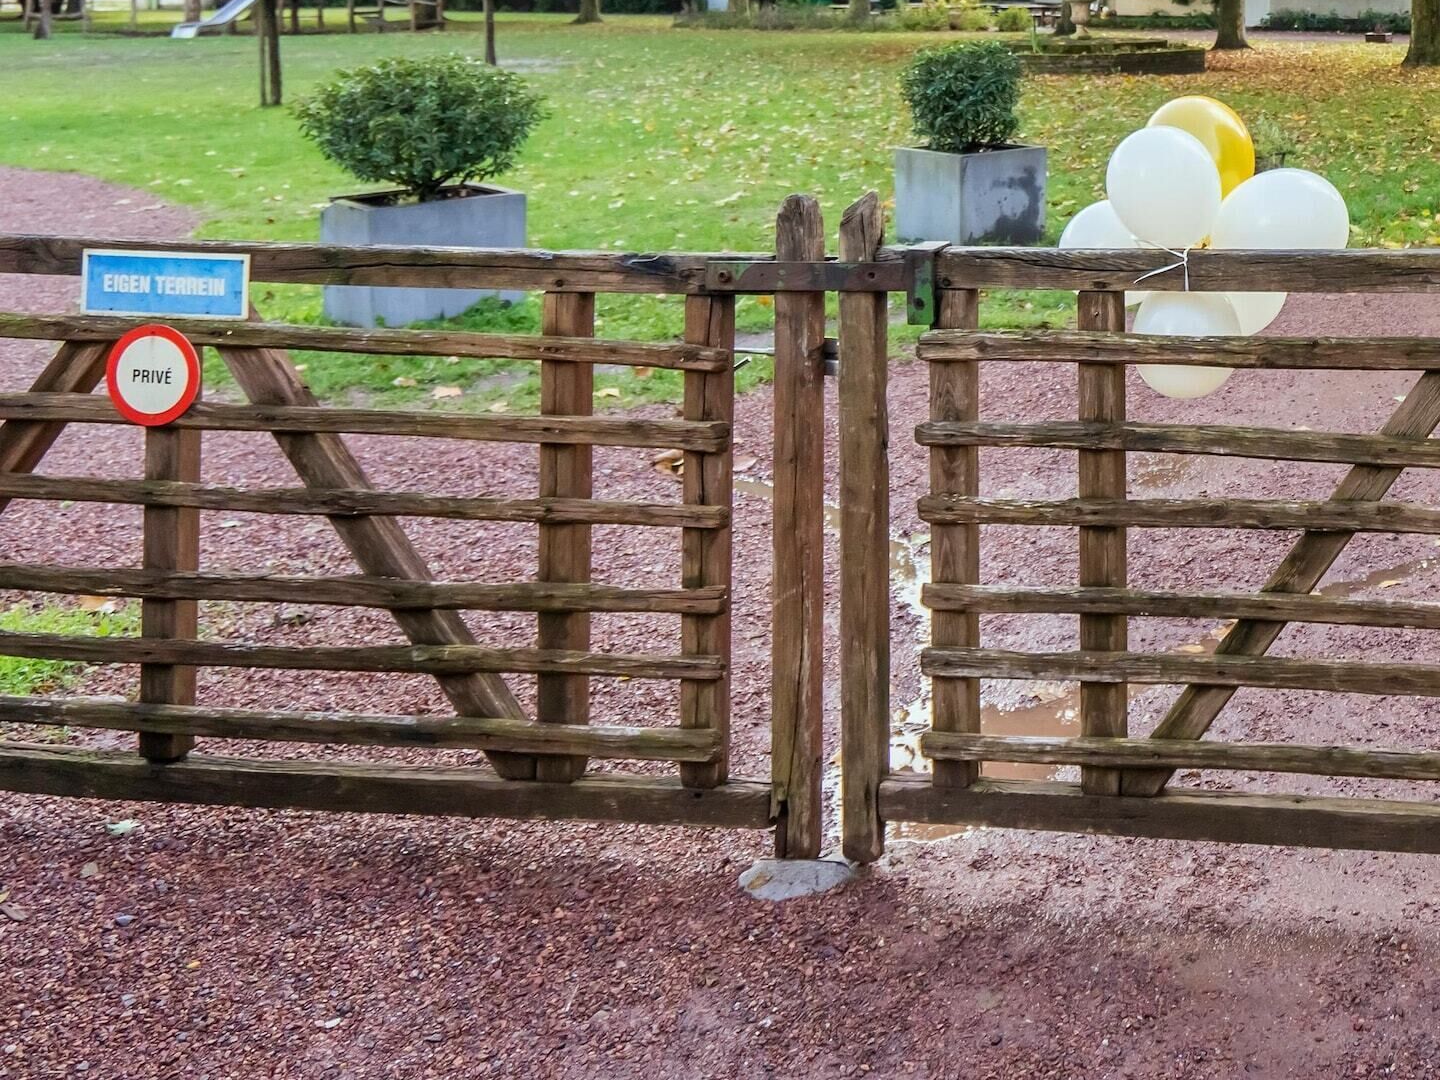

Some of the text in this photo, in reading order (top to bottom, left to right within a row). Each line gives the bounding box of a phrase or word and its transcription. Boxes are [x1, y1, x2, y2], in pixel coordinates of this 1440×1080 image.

[103, 274, 225, 297] EIGEN TERREIN
[132, 367, 172, 384] PRIVÉ
